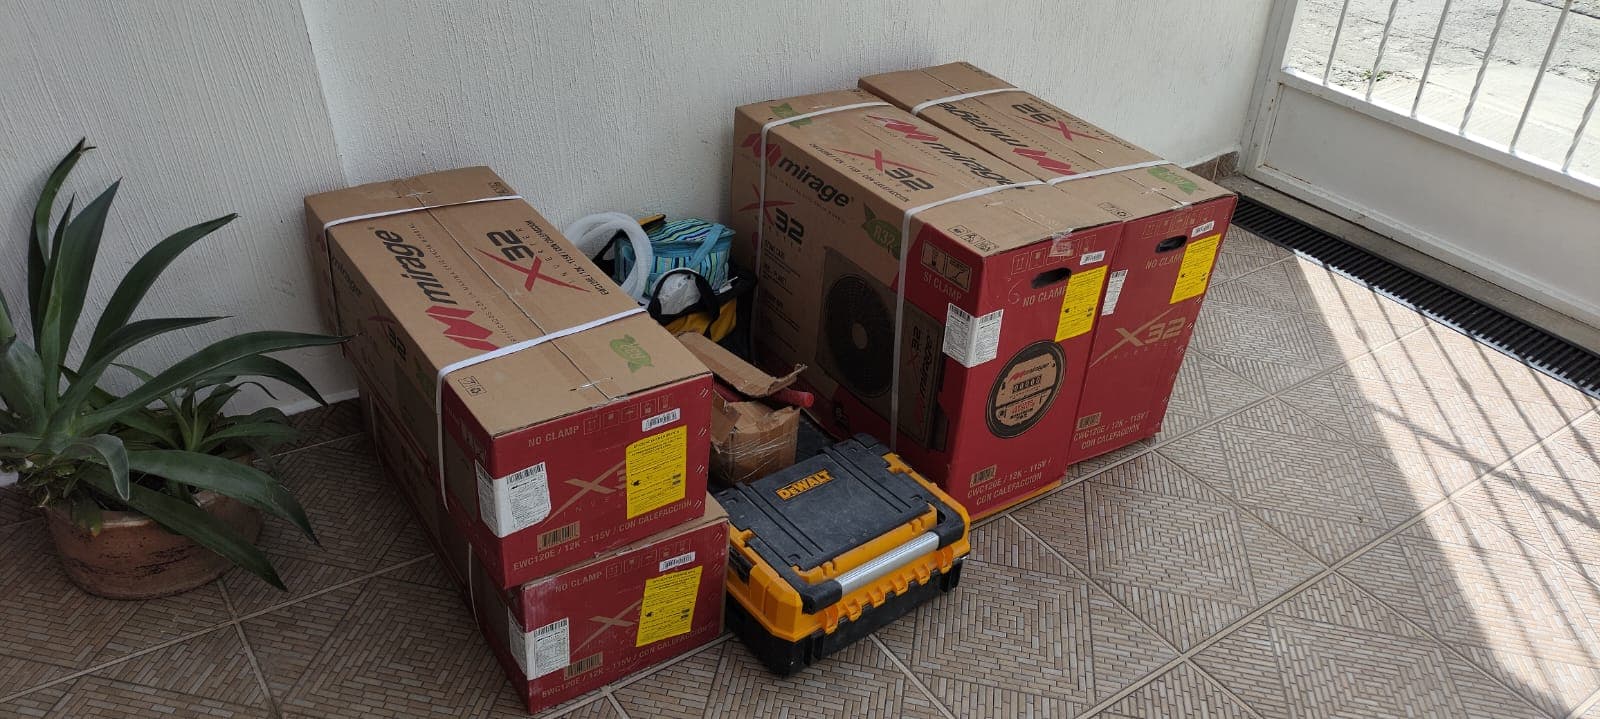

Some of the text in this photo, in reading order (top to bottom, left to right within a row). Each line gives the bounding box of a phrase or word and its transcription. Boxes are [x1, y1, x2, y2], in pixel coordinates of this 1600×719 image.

[778, 156, 849, 207] mirage
[375, 229, 458, 305] mirage
[474, 229, 590, 292] X32
[922, 271, 963, 301] SI CLAMP
[1023, 294, 1036, 308] NO
[1089, 305, 1187, 368] X32
[528, 424, 580, 448] NO CLAMP
[1081, 438, 1097, 450] CON
[976, 492, 992, 506] CON
[513, 549, 556, 571] EWC120E
[564, 540, 581, 553] 12K
[619, 519, 637, 533] CON
[555, 571, 603, 594] NO CLAMP
